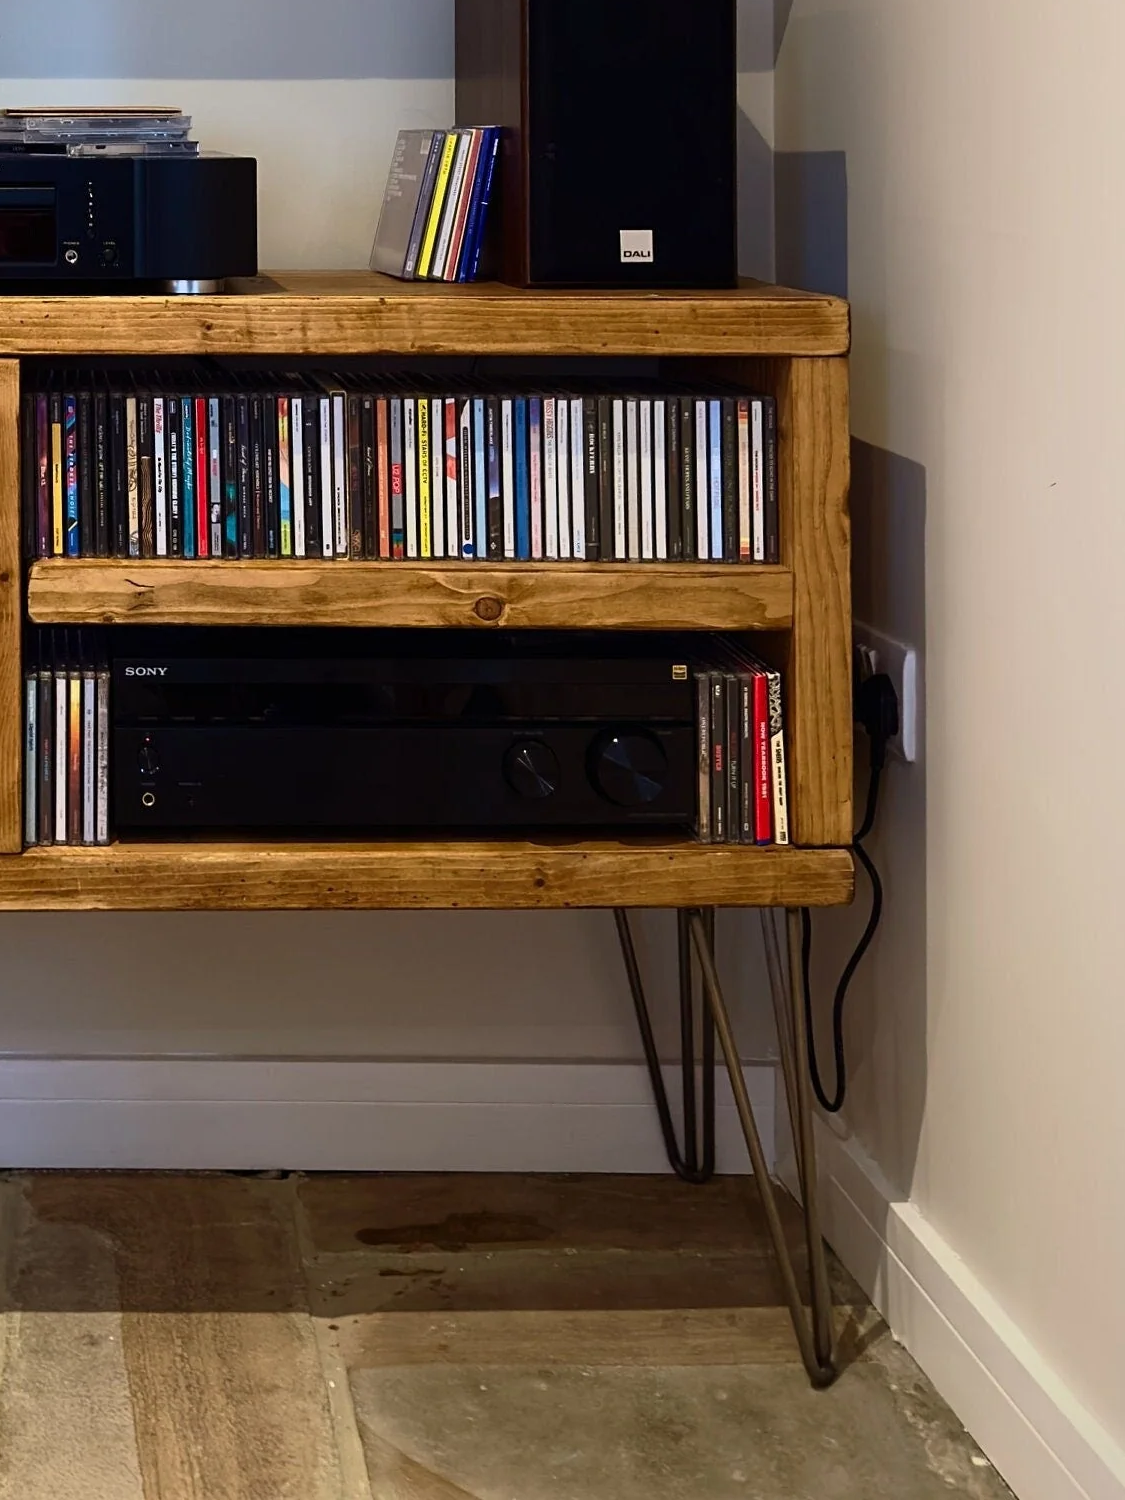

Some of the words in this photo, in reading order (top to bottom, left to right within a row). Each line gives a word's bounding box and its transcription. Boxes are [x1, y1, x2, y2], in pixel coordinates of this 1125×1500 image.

[392, 465, 400, 476] U2
[392, 476, 400, 494] POP
[125, 666, 168, 676] SONY
